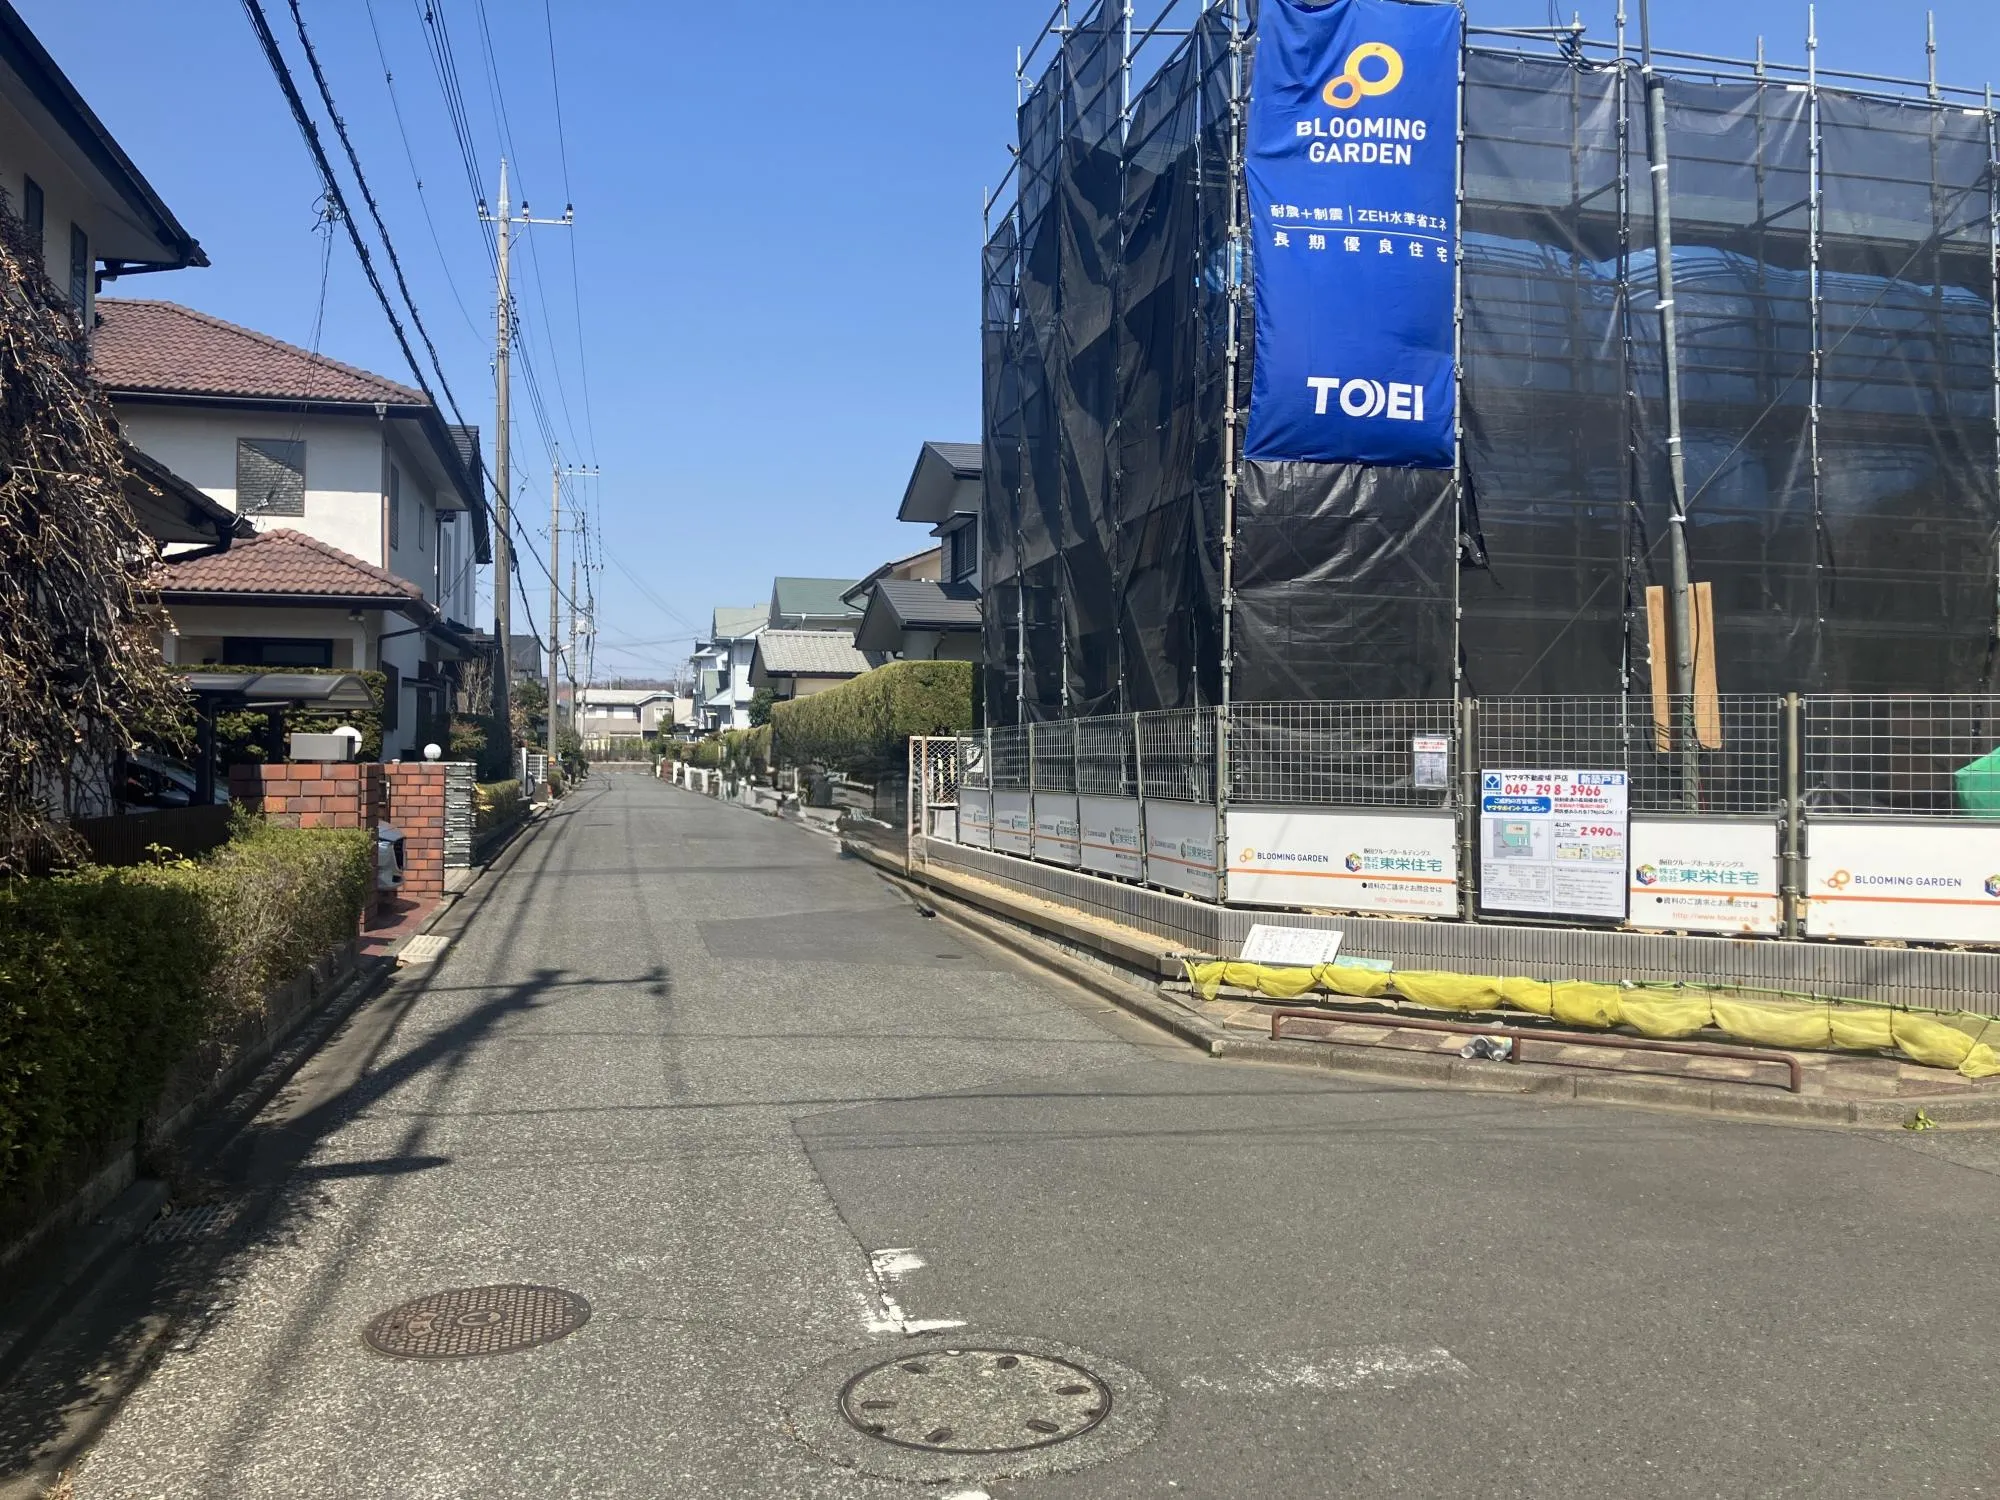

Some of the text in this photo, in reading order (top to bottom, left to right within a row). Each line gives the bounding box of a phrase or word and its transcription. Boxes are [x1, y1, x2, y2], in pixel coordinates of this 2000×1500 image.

[1296, 116, 1427, 141] BLOOMING
[1309, 141, 1412, 166] GARDEN
[1270, 203, 1448, 232] 耐震＋制震 ZEH水準省エネ
[1273, 231, 1448, 263] 長期優良住宅
[1306, 376, 1424, 421] TOEI
[1505, 783, 1601, 796] 049-298-3966
[1257, 852, 1329, 862] BLOOMING GARDEN
[1380, 857, 1443, 872] 東栄住宅
[1680, 868, 1760, 885] 東栄住宅
[1854, 875, 1962, 887] BLOOMING GARDEN
